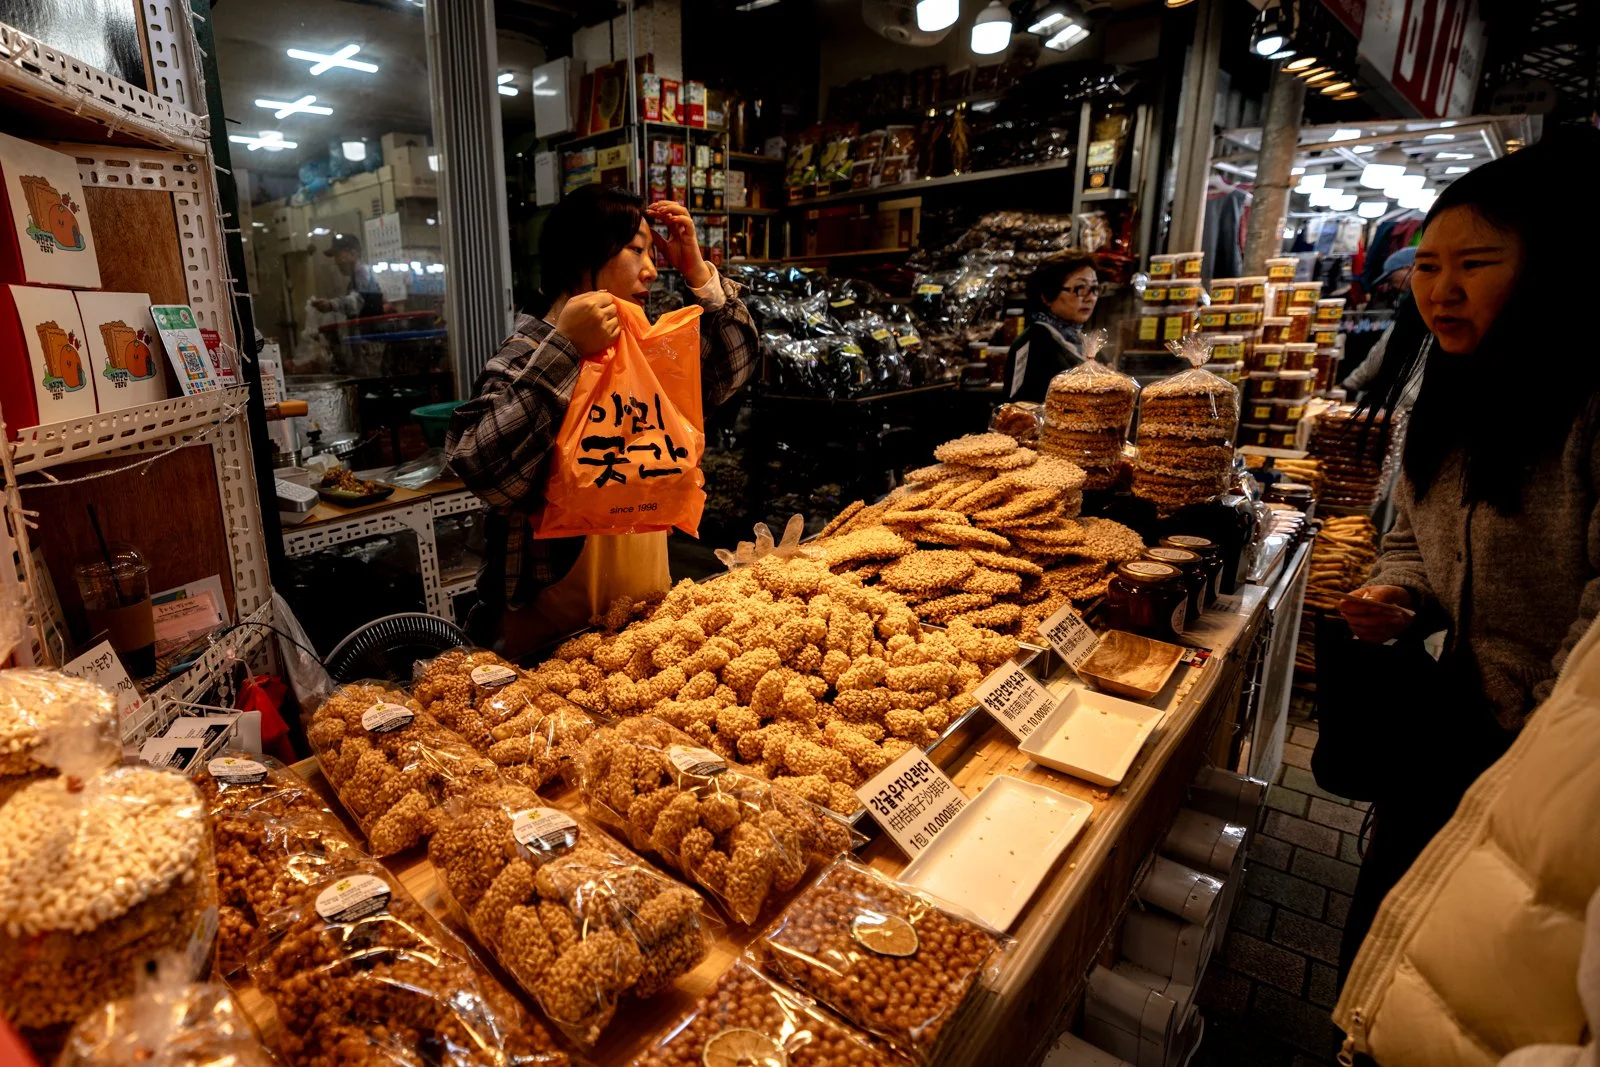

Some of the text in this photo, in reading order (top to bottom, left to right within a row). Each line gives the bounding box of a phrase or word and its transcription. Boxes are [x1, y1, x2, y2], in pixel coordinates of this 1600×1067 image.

[577, 434, 689, 488] 곳간
[609, 502, 658, 514] since 1998
[870, 759, 935, 816] 감귤유자오란다
[888, 776, 951, 834] 柑桔柚子沙琪玛
[909, 833, 929, 850] 1包
